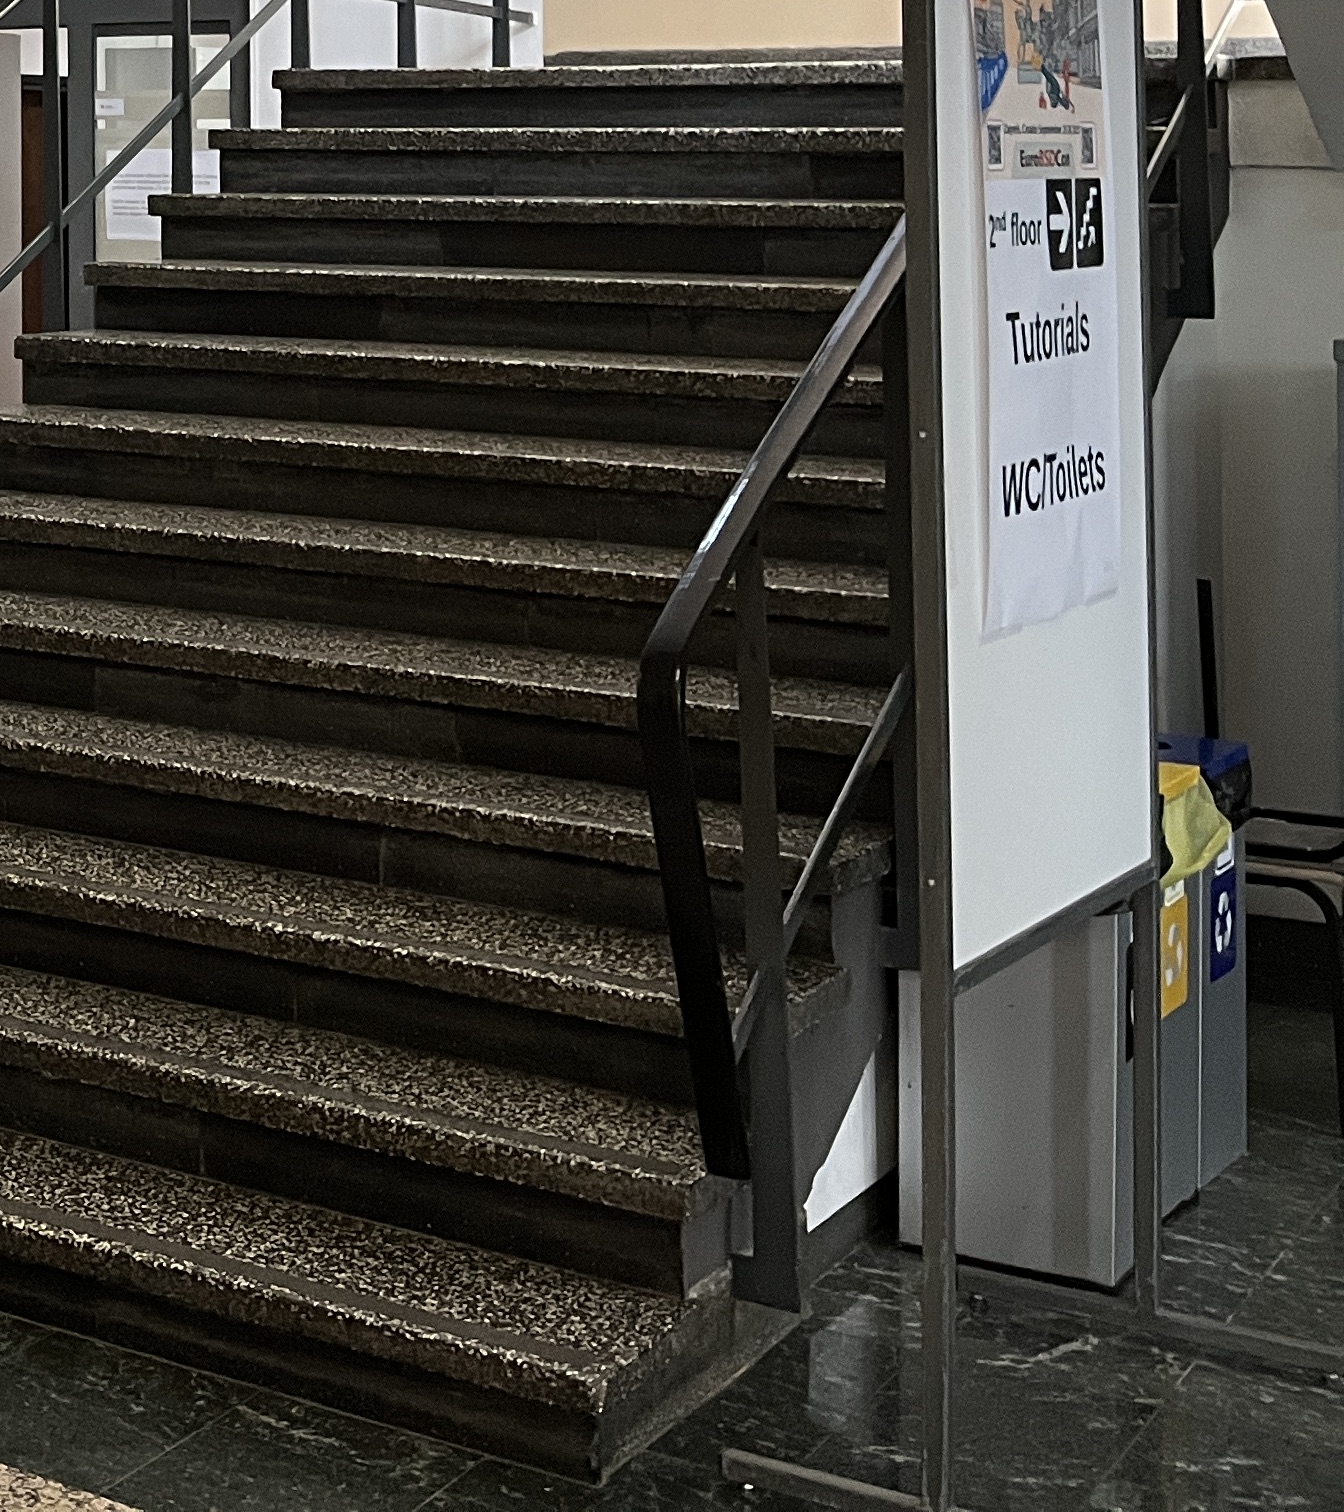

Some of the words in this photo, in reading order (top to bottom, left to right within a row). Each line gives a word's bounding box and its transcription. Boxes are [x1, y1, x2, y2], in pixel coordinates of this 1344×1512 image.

[988, 211, 1007, 250] 2nd
[1011, 212, 1042, 247] floor
[1005, 300, 1090, 365] Tutorials
[1002, 444, 1107, 518] WC/Toilets
